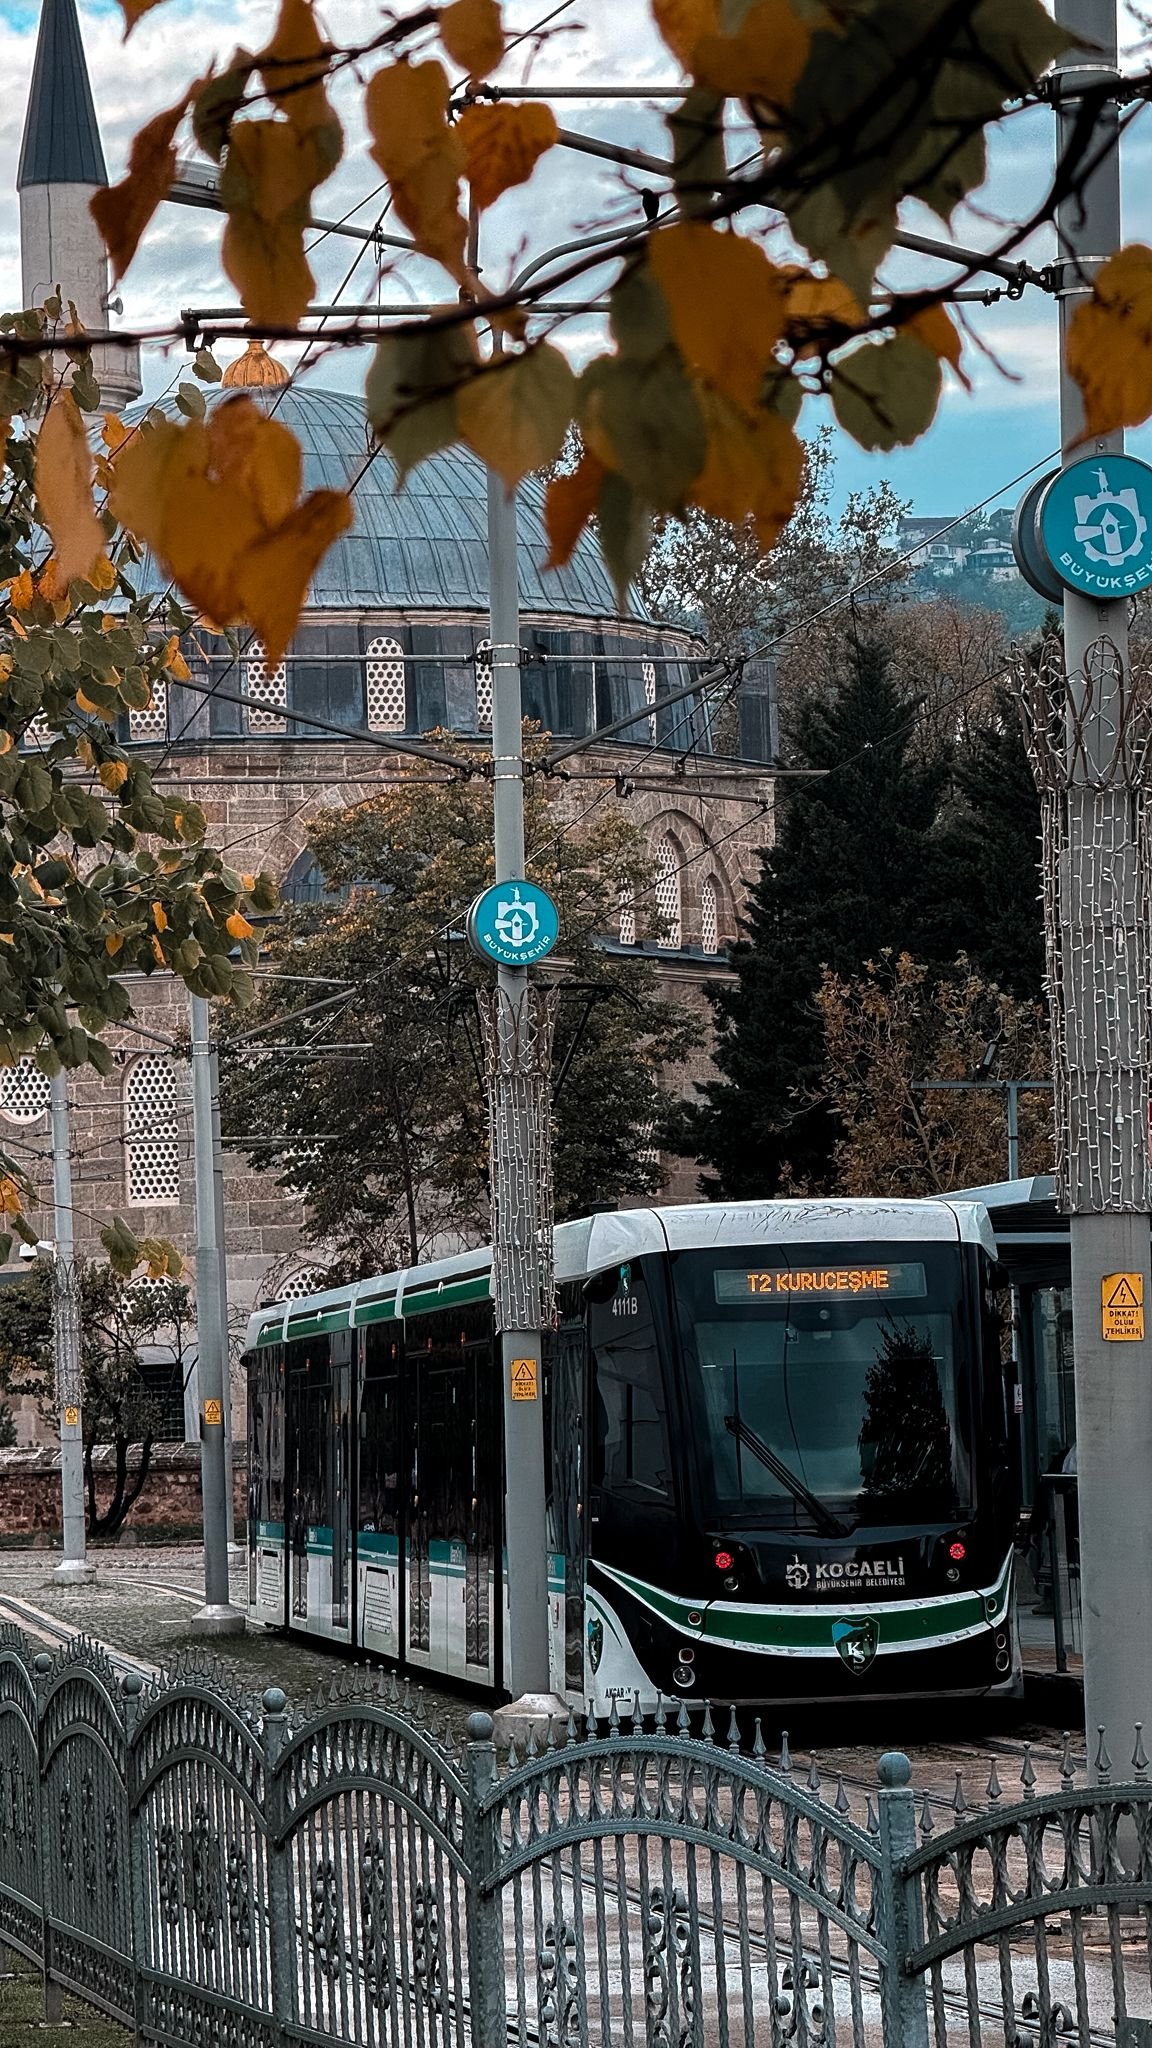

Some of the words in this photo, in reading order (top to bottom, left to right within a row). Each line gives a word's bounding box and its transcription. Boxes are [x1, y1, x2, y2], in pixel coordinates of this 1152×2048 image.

[483, 933, 551, 961] BÜYÜKŞEHİR
[747, 1274, 772, 1292] T2
[612, 1297, 638, 1316] 4111B
[815, 1556, 905, 1579] KOCAELİ
